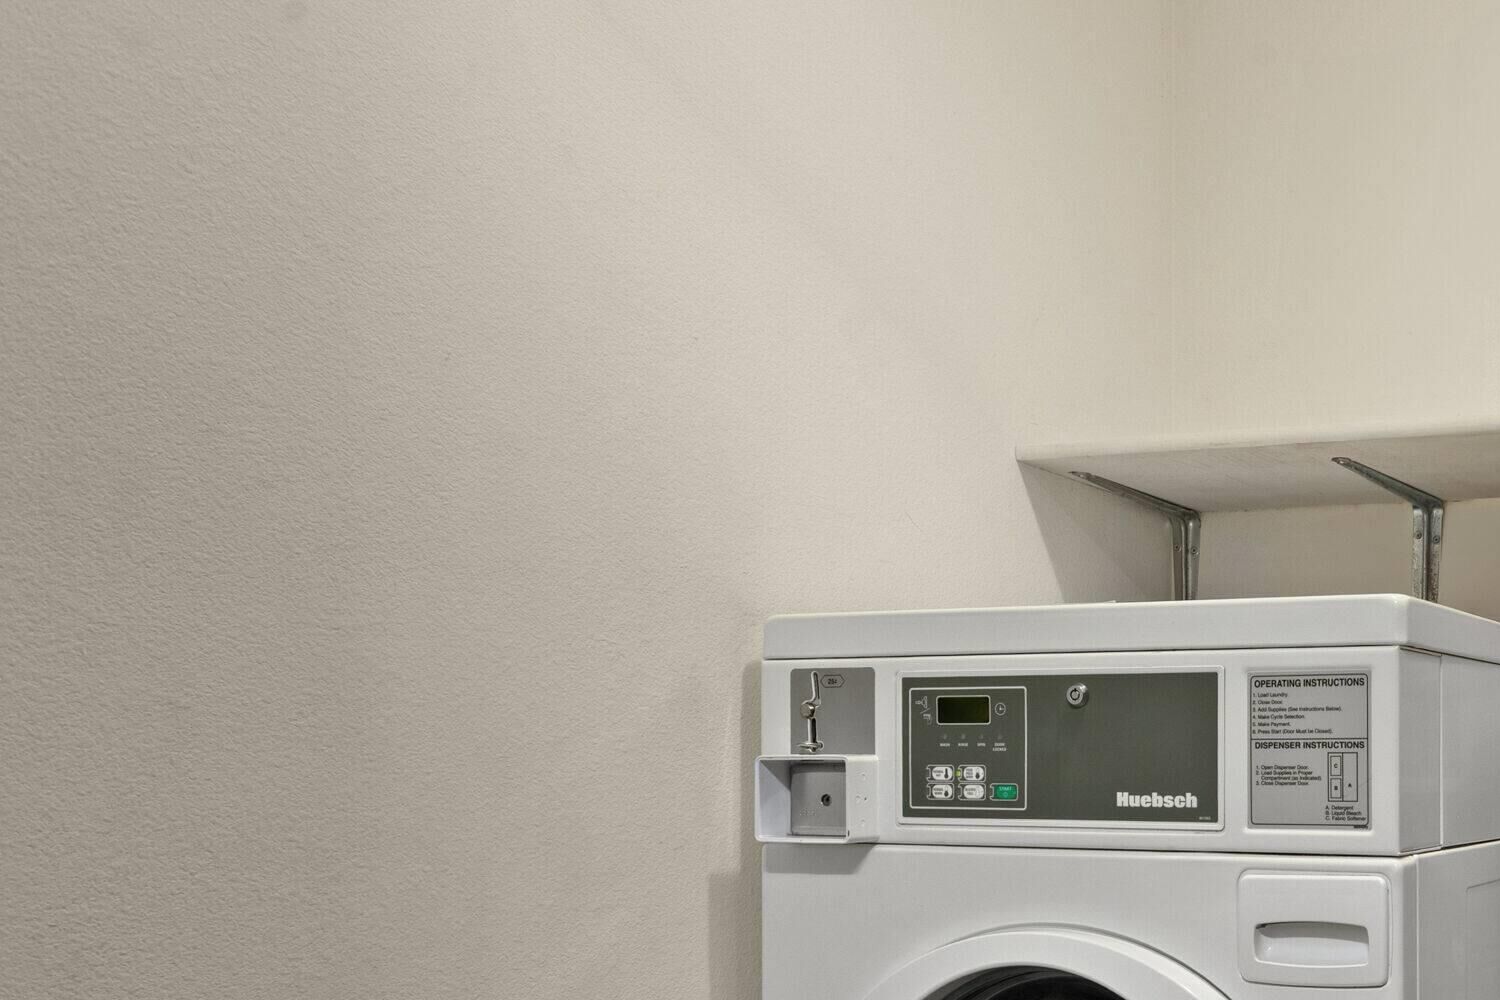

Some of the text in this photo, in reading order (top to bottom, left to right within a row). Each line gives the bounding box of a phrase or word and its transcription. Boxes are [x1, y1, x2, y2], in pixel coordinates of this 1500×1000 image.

[1254, 678, 1364, 688] OPERATING INSTRUCTIONS
[1255, 742, 1364, 750] DISPENSER INSTRUCTIONS
[1116, 792, 1198, 808] Huebsch
